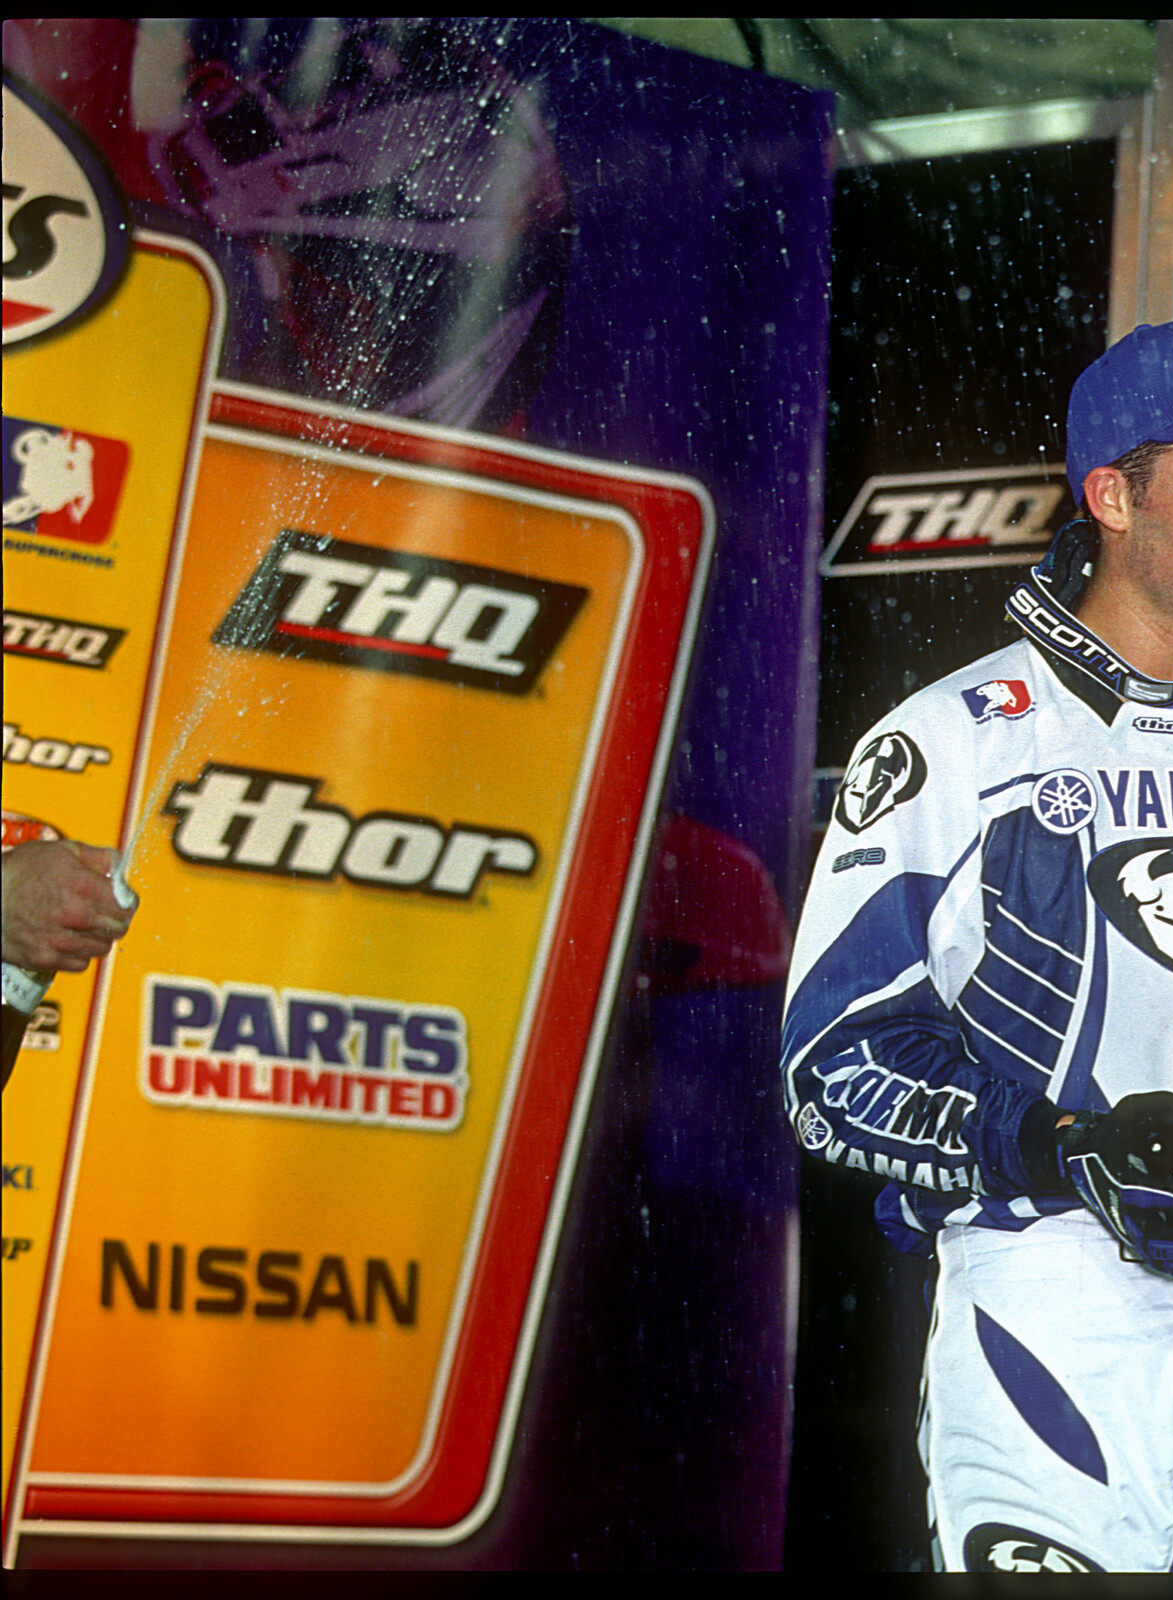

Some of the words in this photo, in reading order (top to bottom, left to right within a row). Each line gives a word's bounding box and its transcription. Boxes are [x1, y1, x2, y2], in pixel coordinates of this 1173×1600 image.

[868, 485, 1064, 546] THQ
[3, 613, 109, 665] THQ
[277, 549, 541, 677] THQ
[1009, 587, 1130, 676] SCOTT
[3, 723, 111, 773] hor
[165, 764, 539, 898] thor
[150, 982, 461, 1076] PARTS
[148, 1054, 459, 1121] UNLIMITED
[101, 1239, 419, 1329] NISSAN
